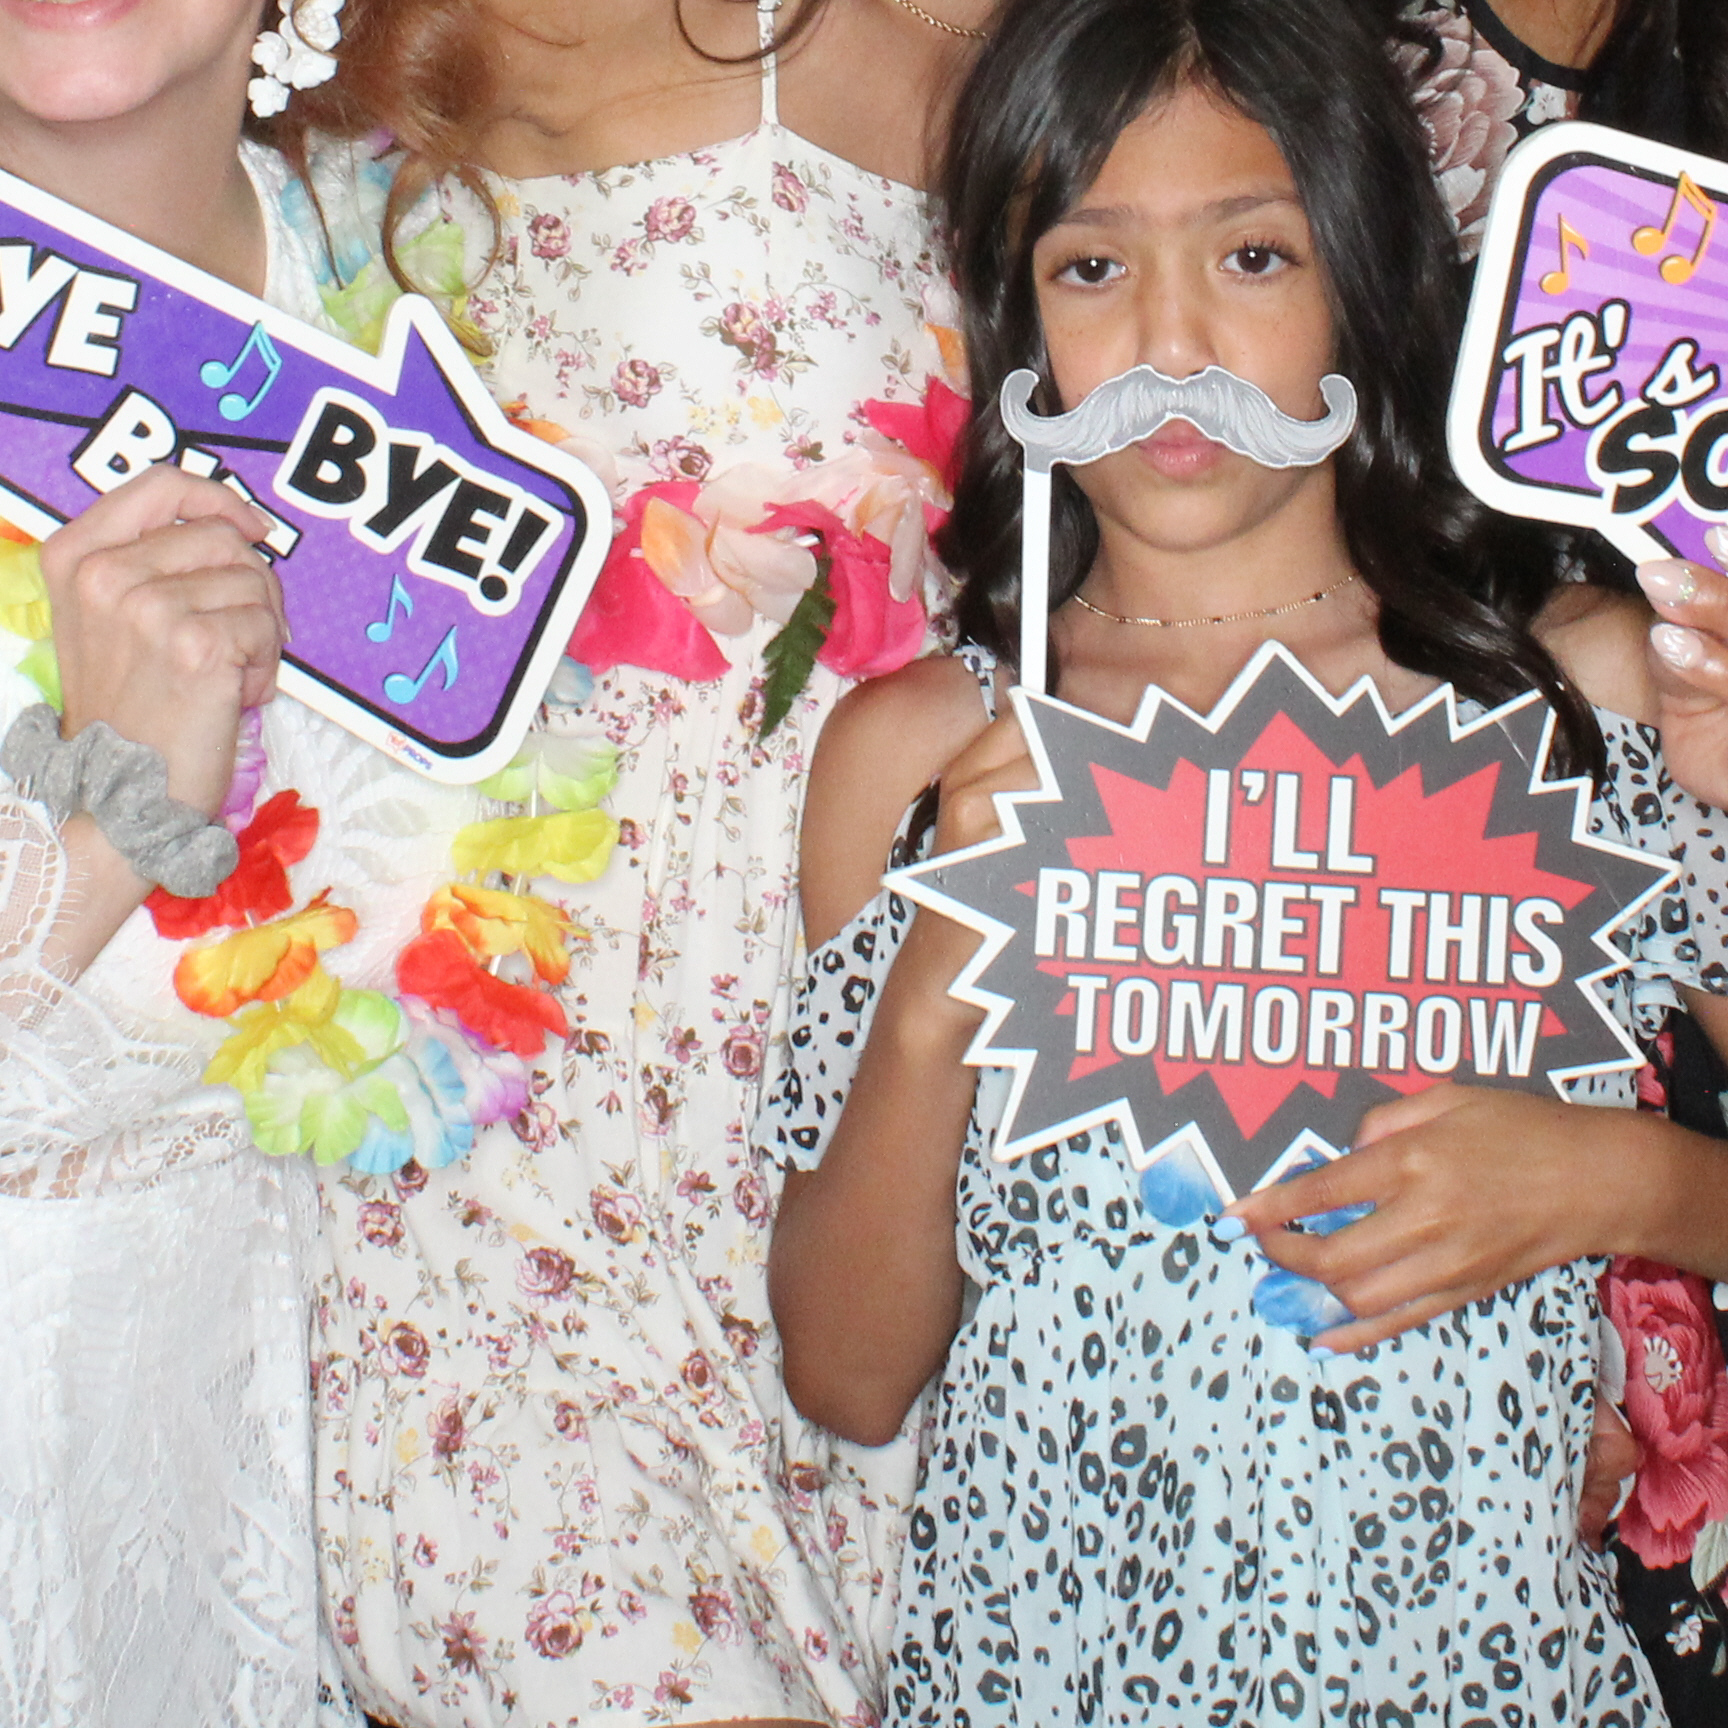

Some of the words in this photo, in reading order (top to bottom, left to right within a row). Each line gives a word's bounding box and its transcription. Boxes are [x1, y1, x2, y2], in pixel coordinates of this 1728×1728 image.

[1500, 303, 1718, 453] It's
[288, 402, 554, 603] BYE!
[1204, 769, 1374, 873] I'LL
[1034, 869, 1355, 975] REGRET
[1380, 889, 1566, 988] THIS
[1067, 974, 1542, 1078] TOMORROW
